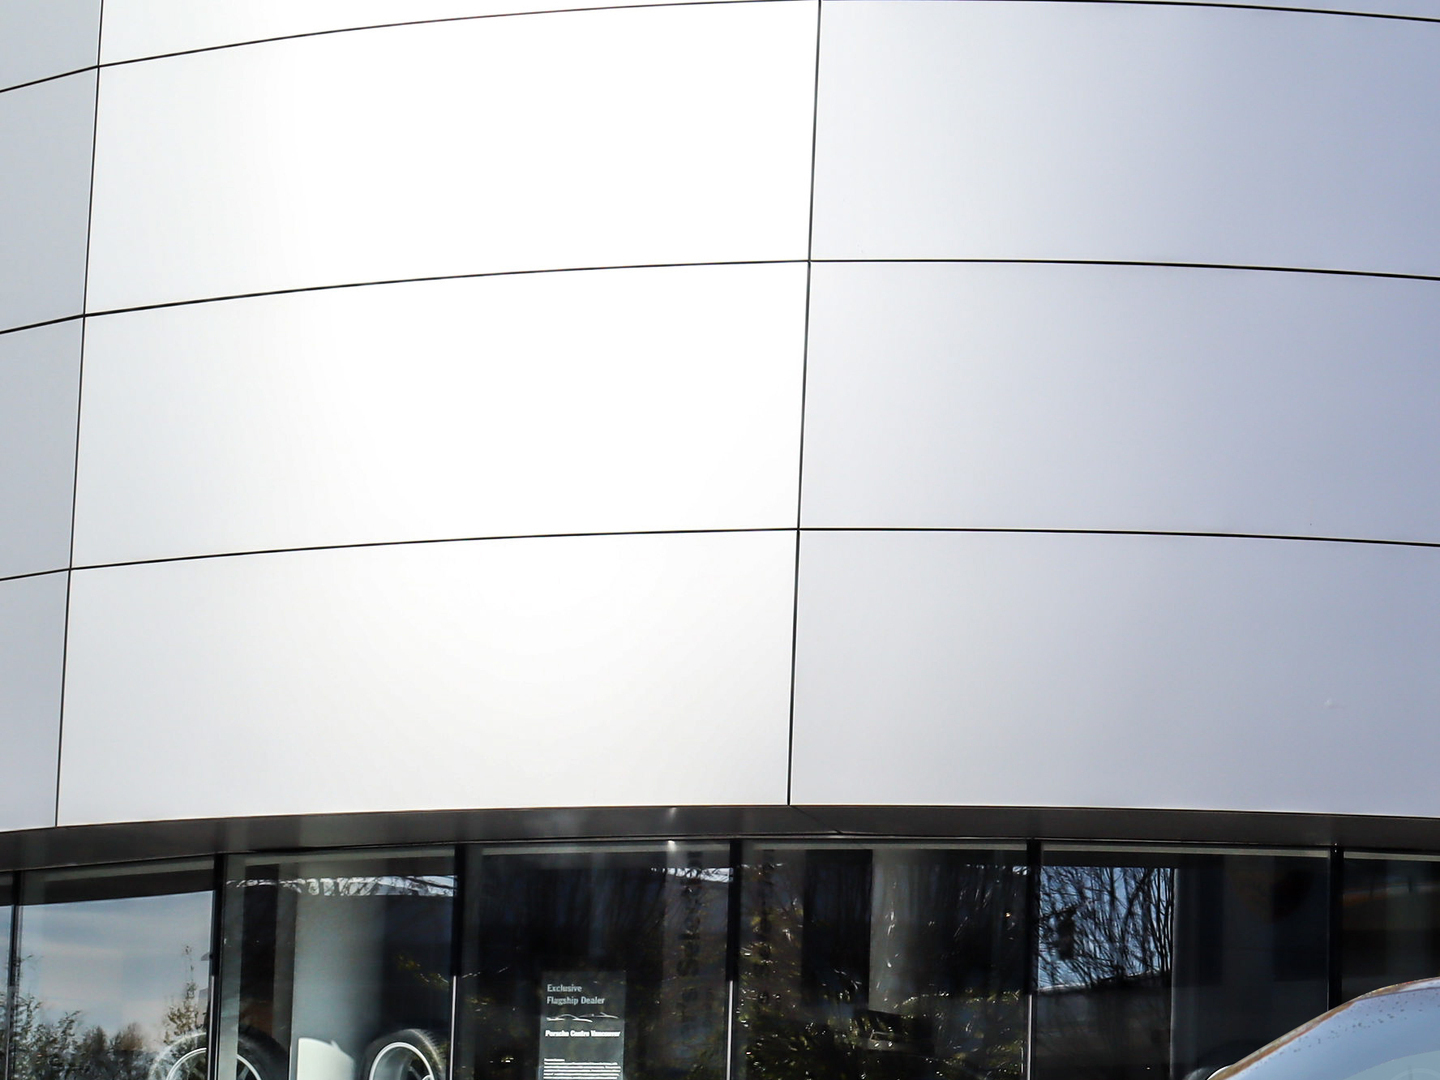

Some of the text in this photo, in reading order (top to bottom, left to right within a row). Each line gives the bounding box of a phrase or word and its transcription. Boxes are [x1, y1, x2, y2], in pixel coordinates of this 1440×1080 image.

[546, 984, 583, 993] Exclusive
[546, 996, 606, 1006] Flagship Dealer
